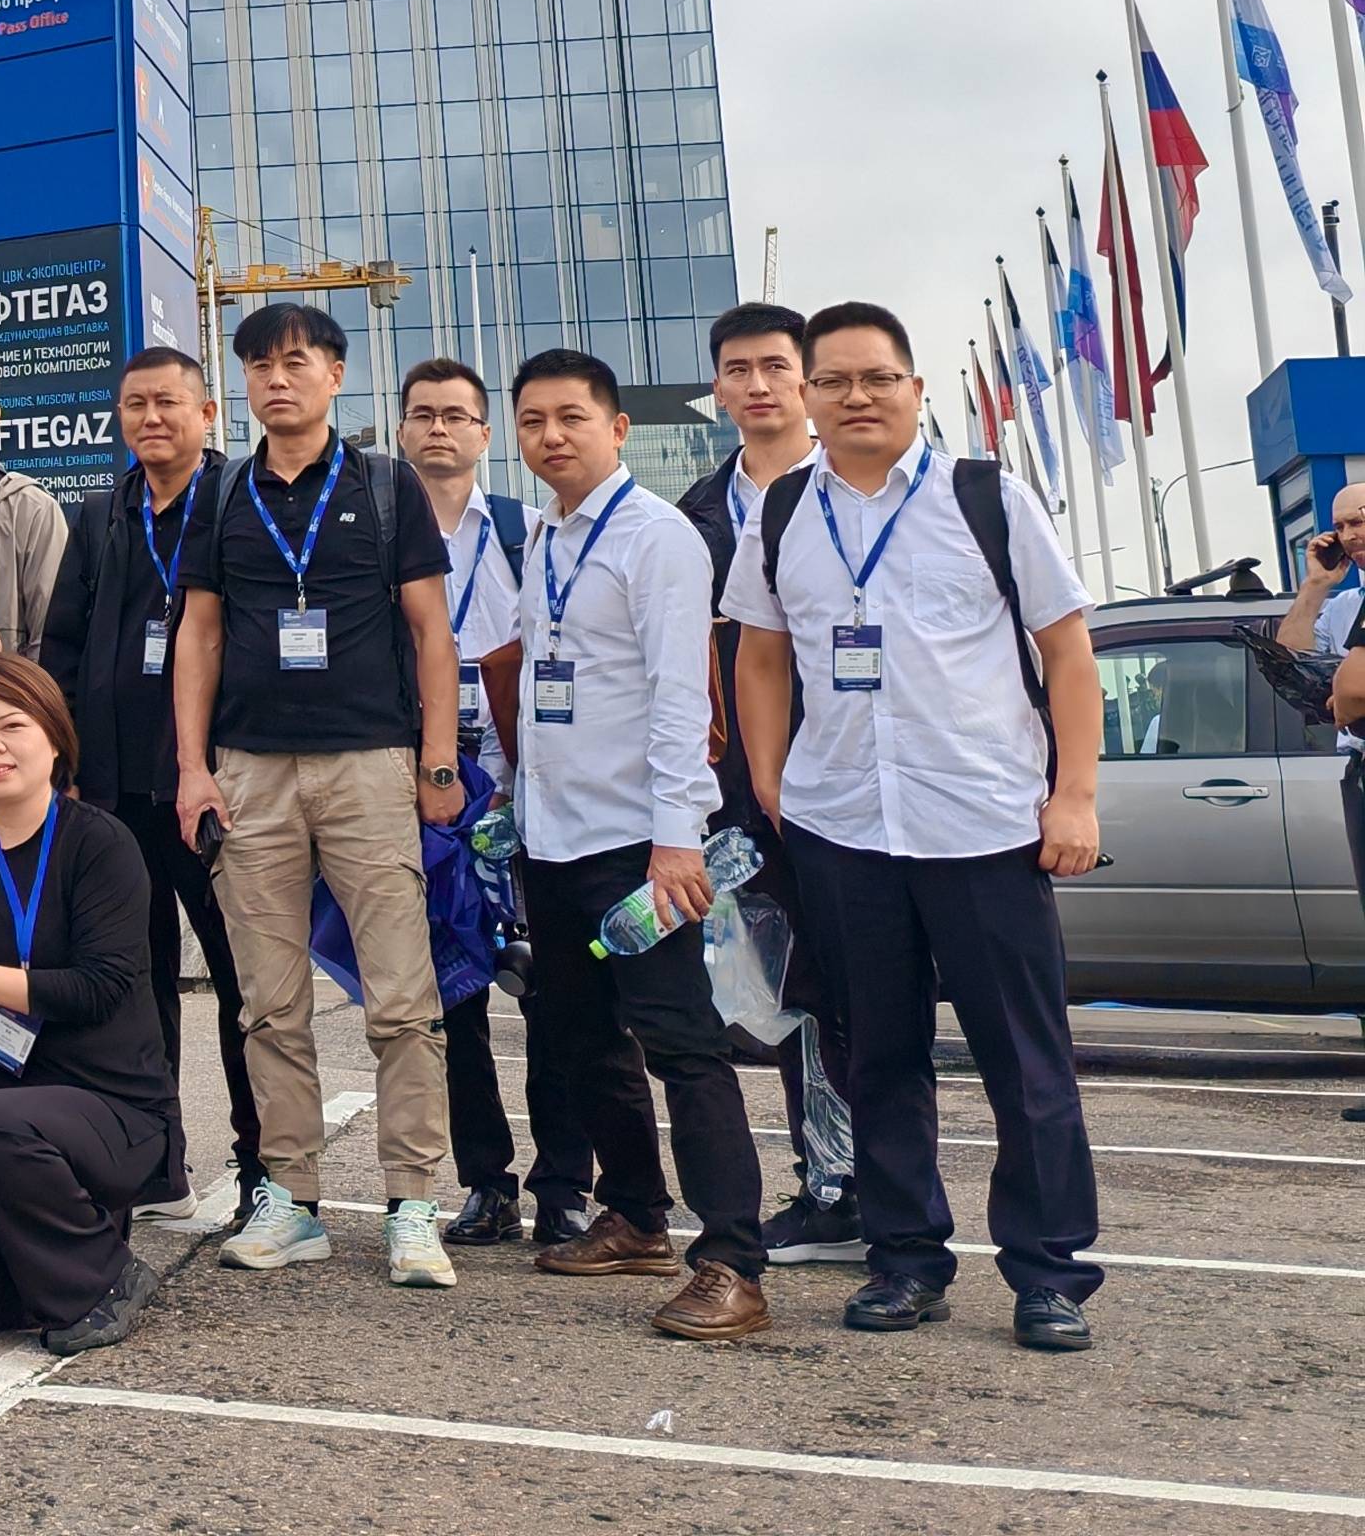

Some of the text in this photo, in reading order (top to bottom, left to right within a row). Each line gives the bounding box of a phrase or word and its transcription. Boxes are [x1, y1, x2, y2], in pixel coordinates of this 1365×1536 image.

[29, 12, 69, 29] Office
[3, 269, 24, 284] ЦВК
[26, 259, 106, 280] «ЭКСПОЦЕНТР»
[23, 349, 31, 360] И
[34, 340, 110, 359] ТЕХНОЛОГИИ
[34, 357, 111, 375] КОМПЛЕКСА»
[79, 389, 112, 402] RUSSIA
[66, 453, 113, 465] EXHIBITION
[57, 490, 85, 504] INDU
